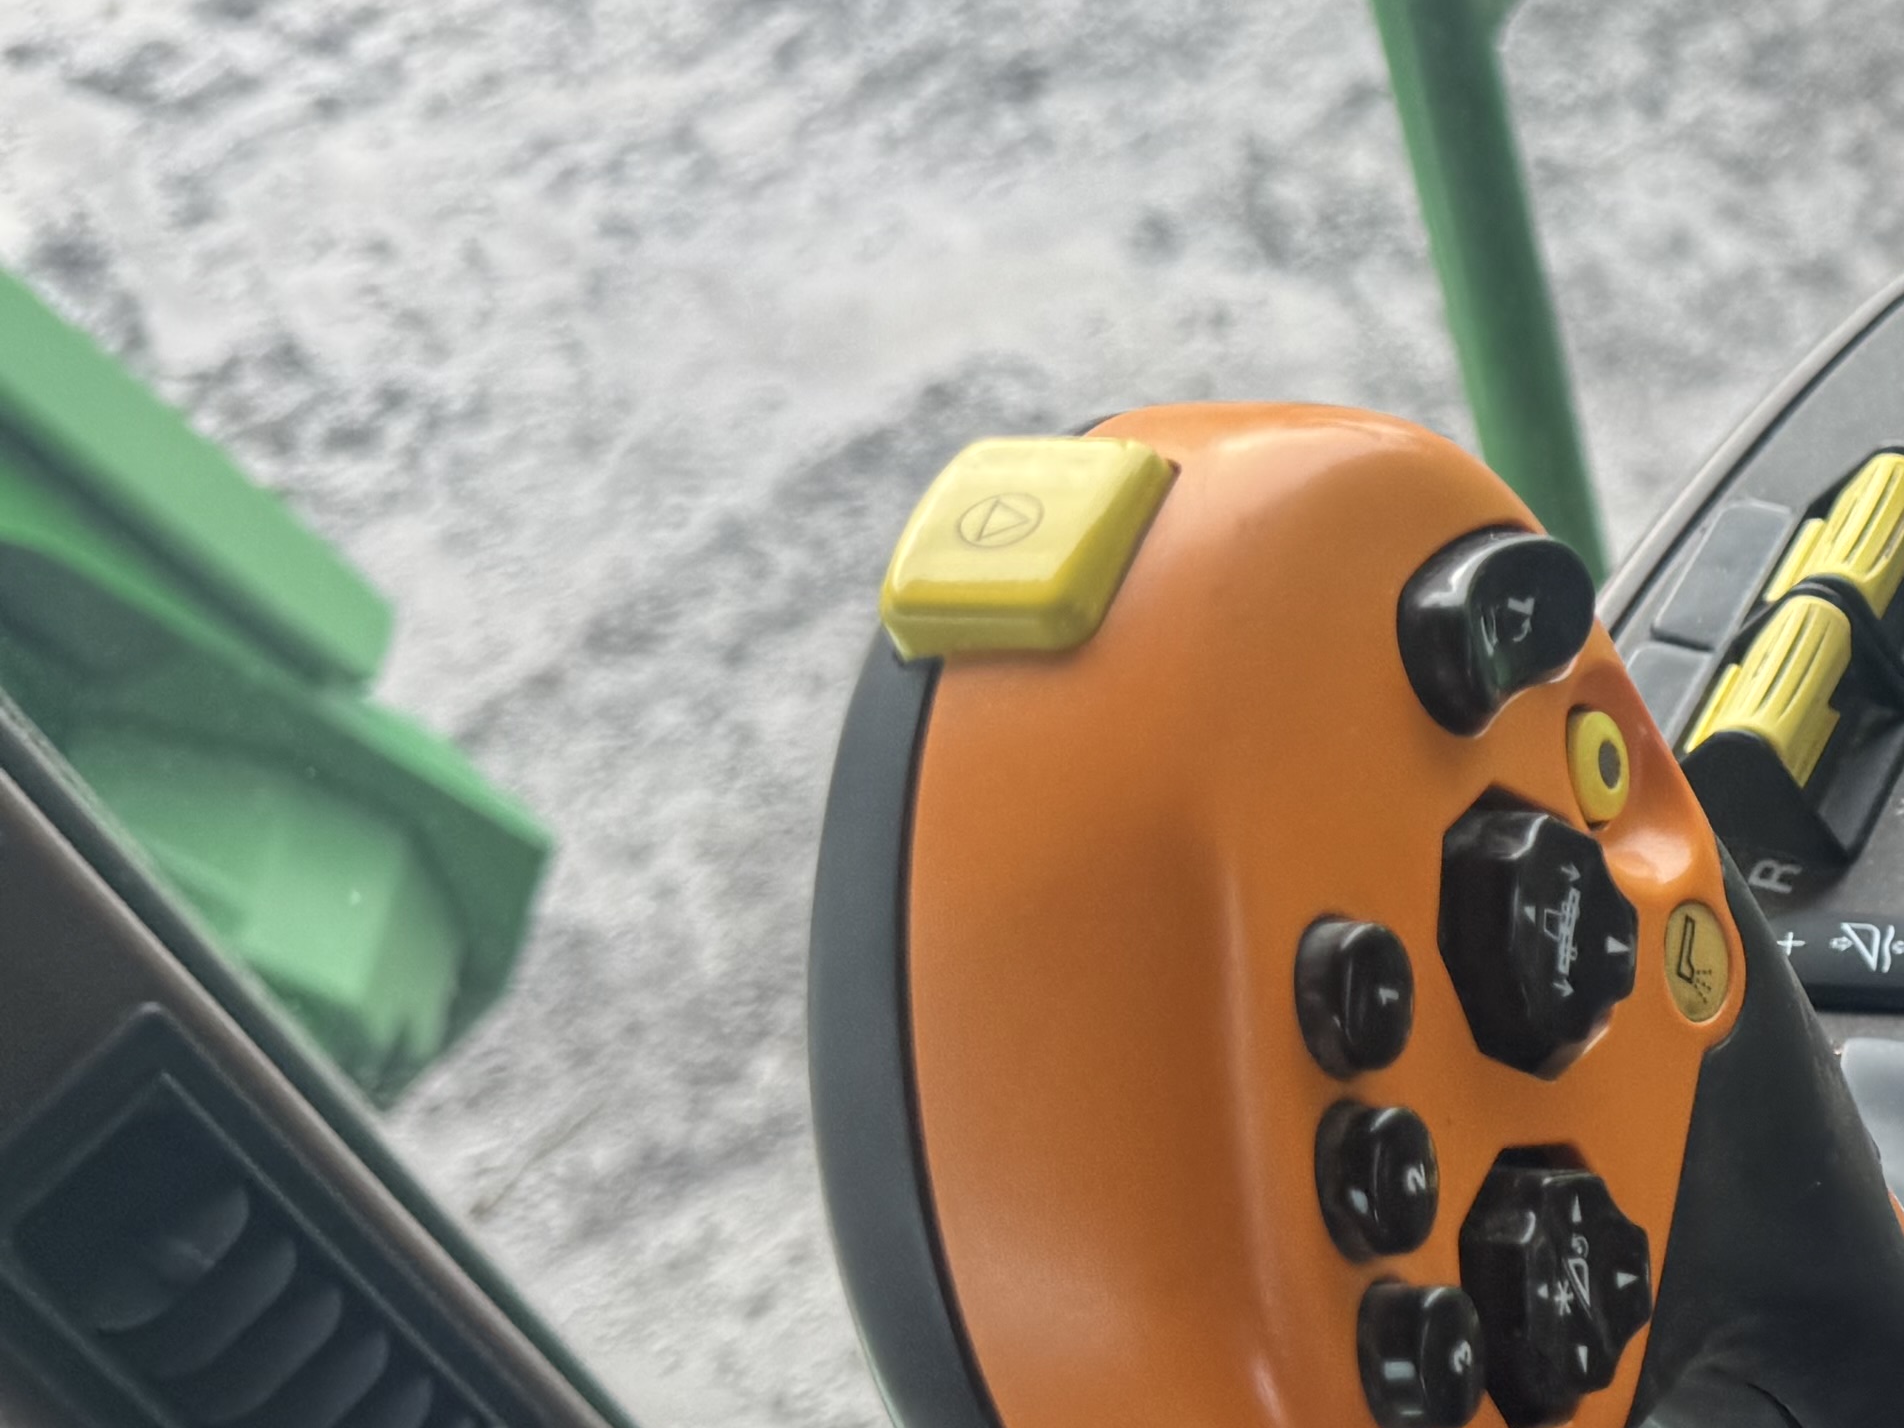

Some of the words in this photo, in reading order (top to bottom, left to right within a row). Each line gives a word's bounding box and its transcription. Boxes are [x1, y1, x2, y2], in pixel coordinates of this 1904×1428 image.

[1748, 859, 1803, 894] R
[1379, 987, 1400, 1005] 1
[1406, 1163, 1427, 1193] 2
[1453, 1340, 1472, 1374] 3
